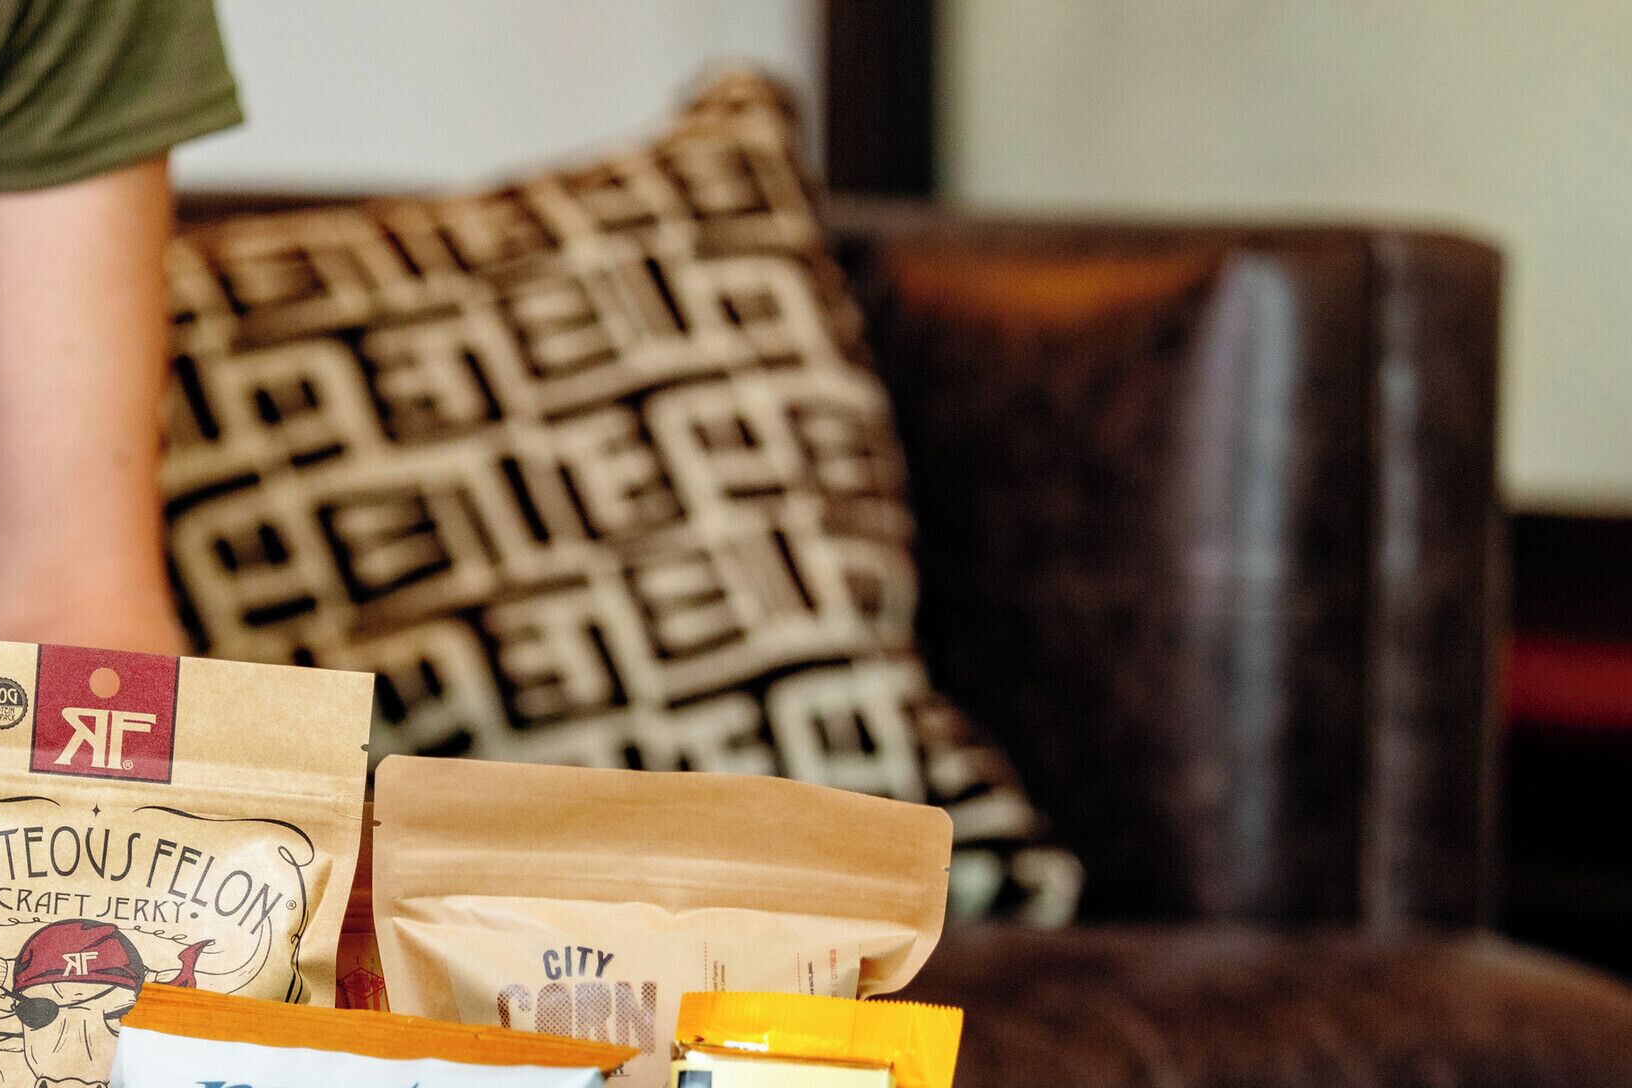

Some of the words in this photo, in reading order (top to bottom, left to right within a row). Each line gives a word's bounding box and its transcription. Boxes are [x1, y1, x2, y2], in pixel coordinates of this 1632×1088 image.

[96, 896, 186, 924] JERKY
[146, 838, 283, 935] FELON
[542, 945, 614, 981] CITY
[497, 980, 657, 1056] CORN
